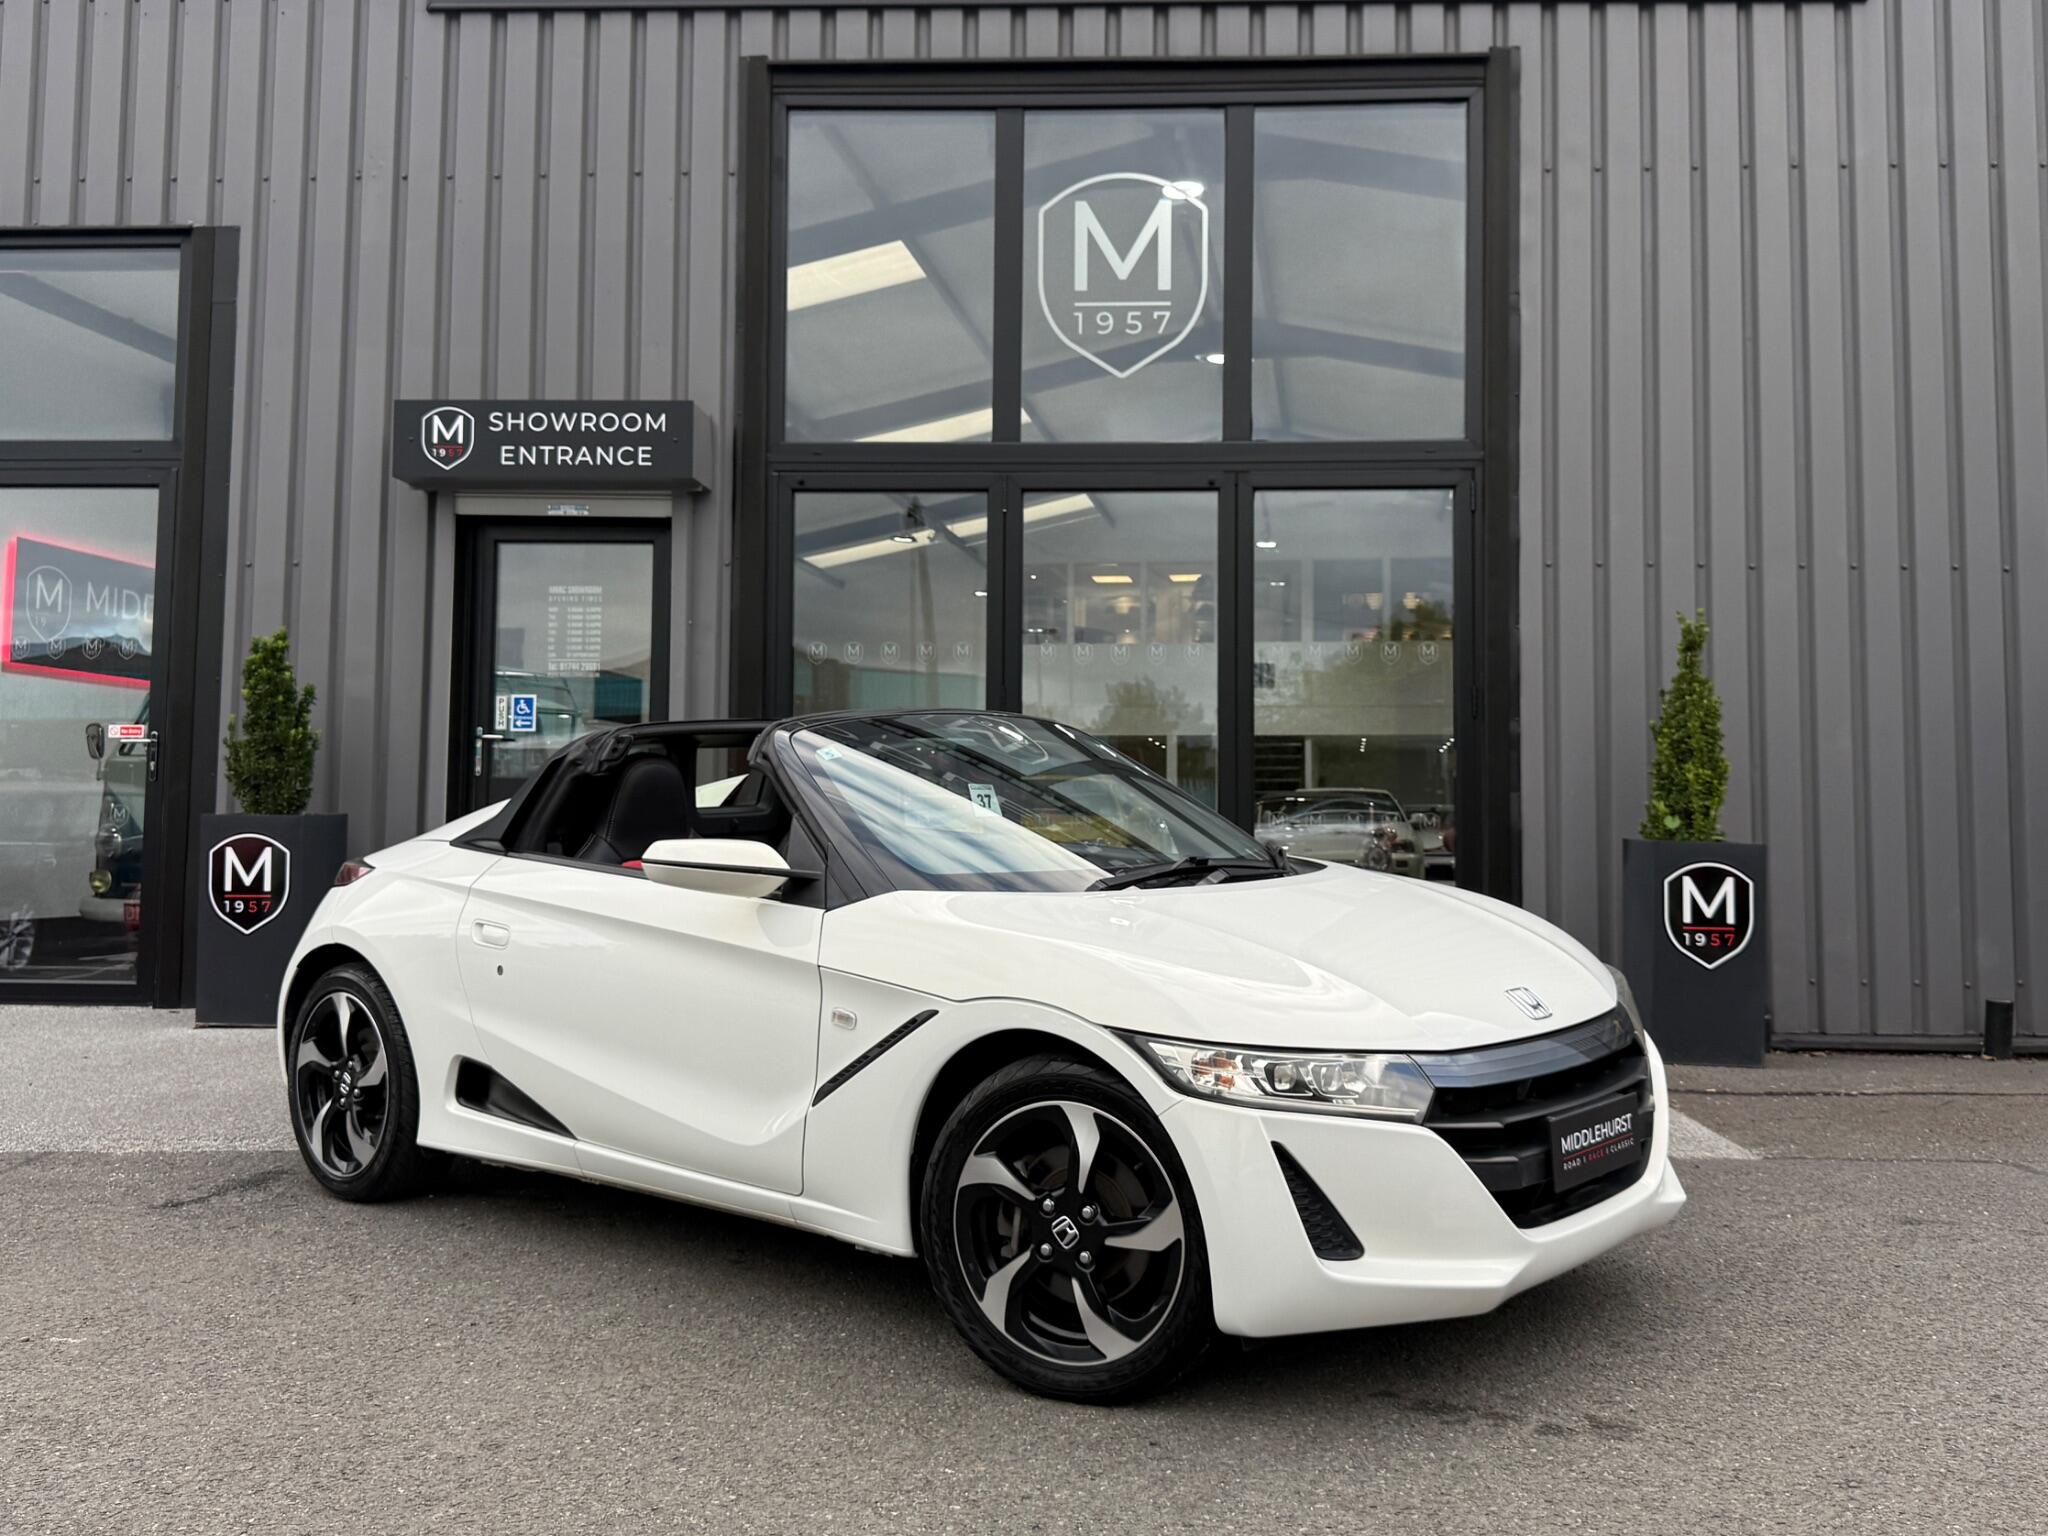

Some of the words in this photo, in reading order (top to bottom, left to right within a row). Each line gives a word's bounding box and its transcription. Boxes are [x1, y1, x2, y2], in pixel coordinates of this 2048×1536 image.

[1074, 200, 1172, 291] M
[1073, 312, 1171, 335] 1957
[433, 414, 464, 444] M
[488, 412, 667, 432] SHOWROOM
[432, 448, 464, 457] 1957
[500, 446, 653, 466] ENTRANCE
[36, 574, 63, 612] M
[976, 793, 992, 808] 37
[224, 846, 273, 892] M
[224, 900, 272, 914] 1957
[1682, 875, 1736, 925] M
[1683, 933, 1736, 947] 1957
[1561, 1113, 1632, 1154] MIDDLEHURST
[1563, 1157, 1582, 1170] ROAD
[1610, 1137, 1635, 1153] CLASSIC
